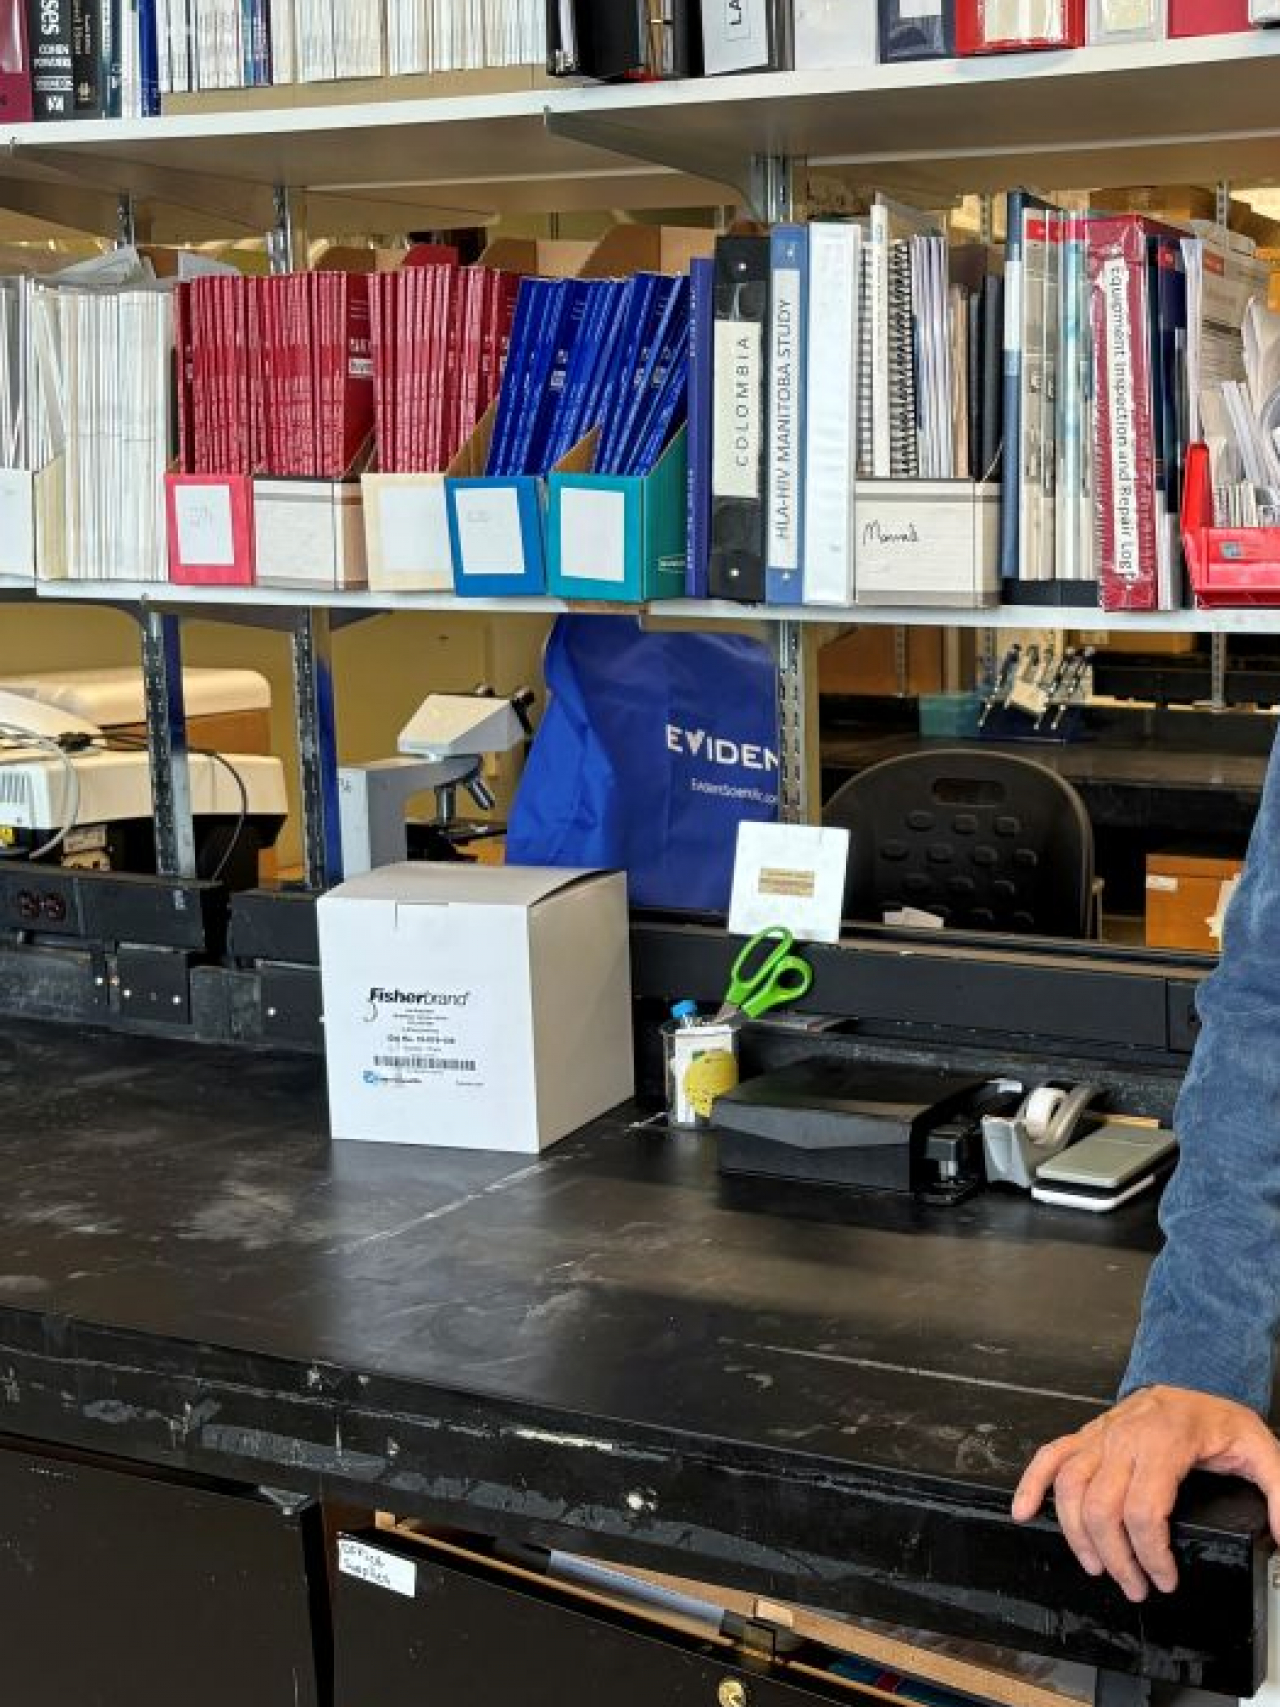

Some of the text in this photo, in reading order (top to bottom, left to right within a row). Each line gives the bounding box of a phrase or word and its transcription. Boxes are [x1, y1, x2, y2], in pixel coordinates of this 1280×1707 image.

[735, 336, 751, 468] COLOMBIA
[775, 298, 791, 541] HLA-HIV MANITOBA STUDY
[1112, 362, 1129, 445] Inspection
[1118, 450, 1132, 481] and
[1117, 484, 1135, 537] Repair
[1119, 541, 1135, 569] Log
[363, 987, 469, 1022] Fisherbrand
